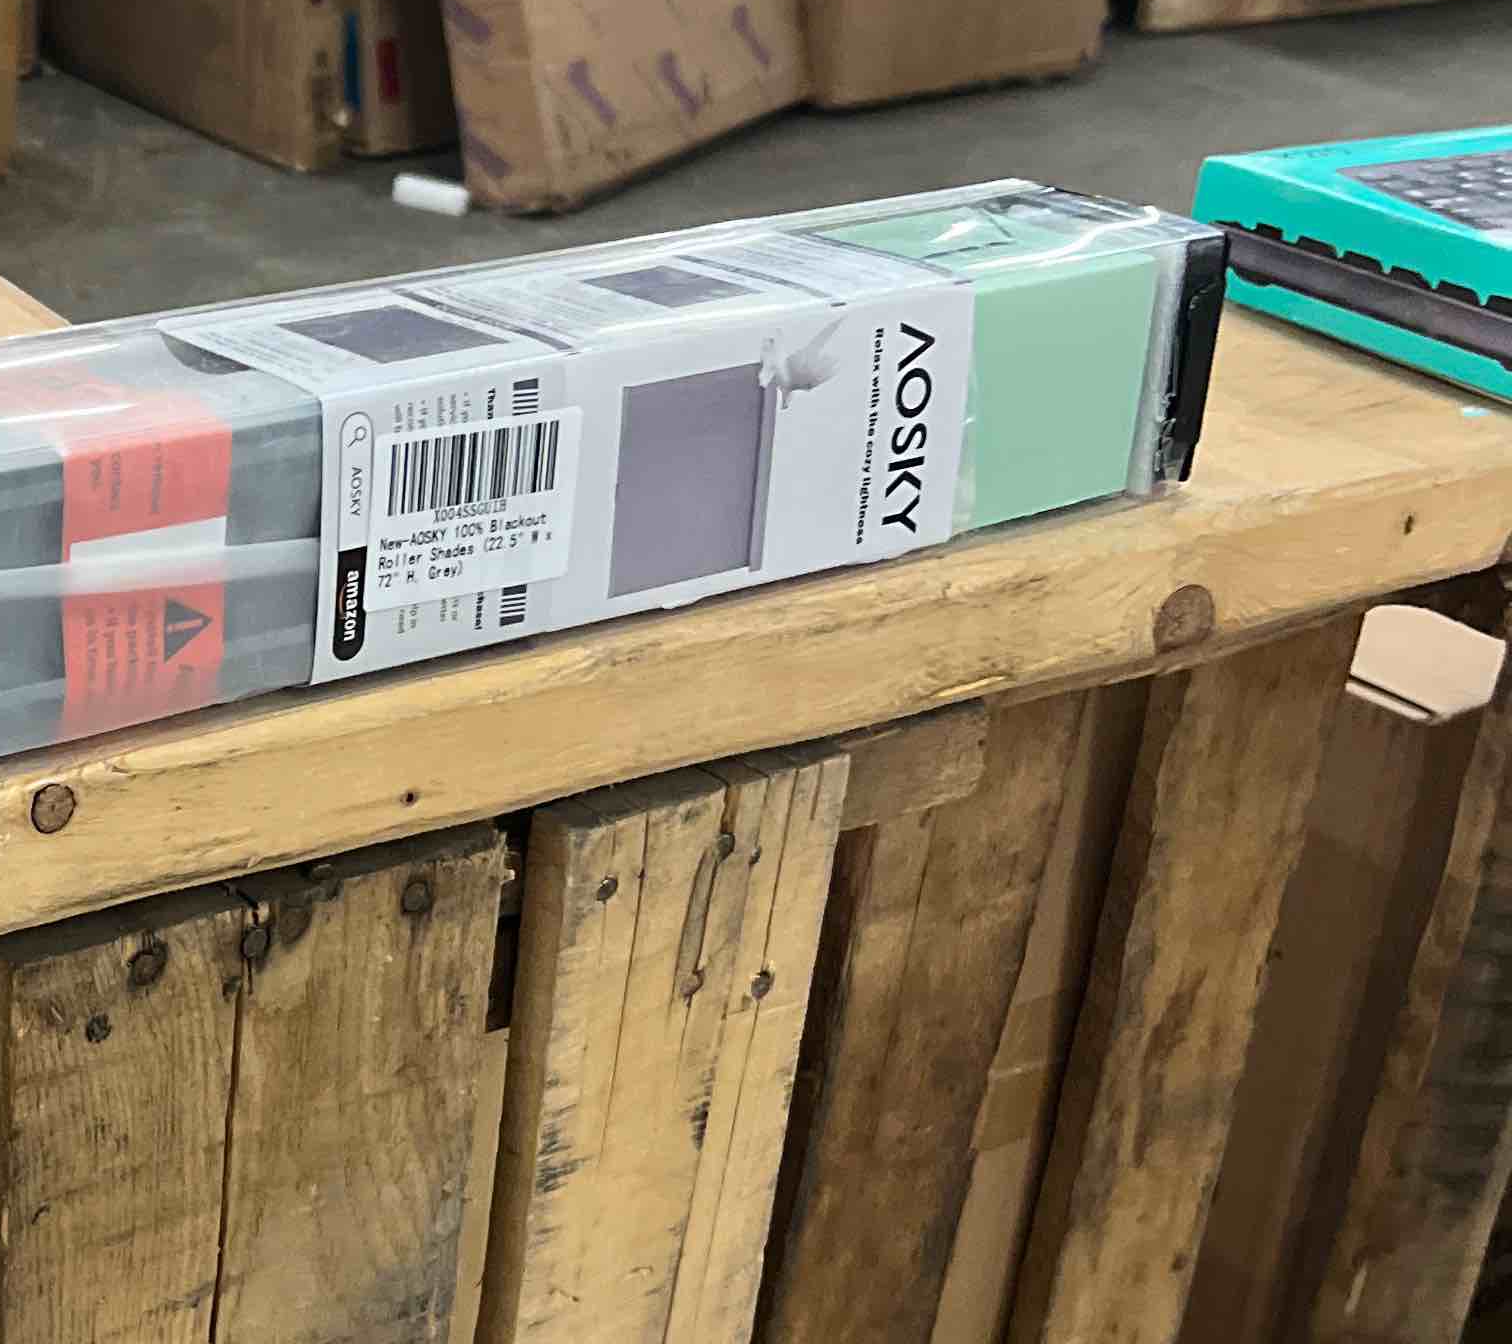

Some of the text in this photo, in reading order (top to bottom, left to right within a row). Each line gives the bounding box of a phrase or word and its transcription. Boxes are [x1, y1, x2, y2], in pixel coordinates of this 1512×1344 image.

[872, 327, 885, 372] Relax
[486, 387, 496, 420] Than
[869, 377, 882, 409] with
[867, 412, 879, 437] the
[881, 322, 936, 534] AOSKY
[347, 465, 363, 517] AOSKY
[455, 521, 484, 540] 100%
[490, 512, 548, 534] Blackout
[856, 477, 872, 545] lightness
[377, 552, 423, 571] Roller
[429, 542, 475, 562] Shades
[428, 559, 464, 580] Grey)
[343, 570, 361, 642] amazon
